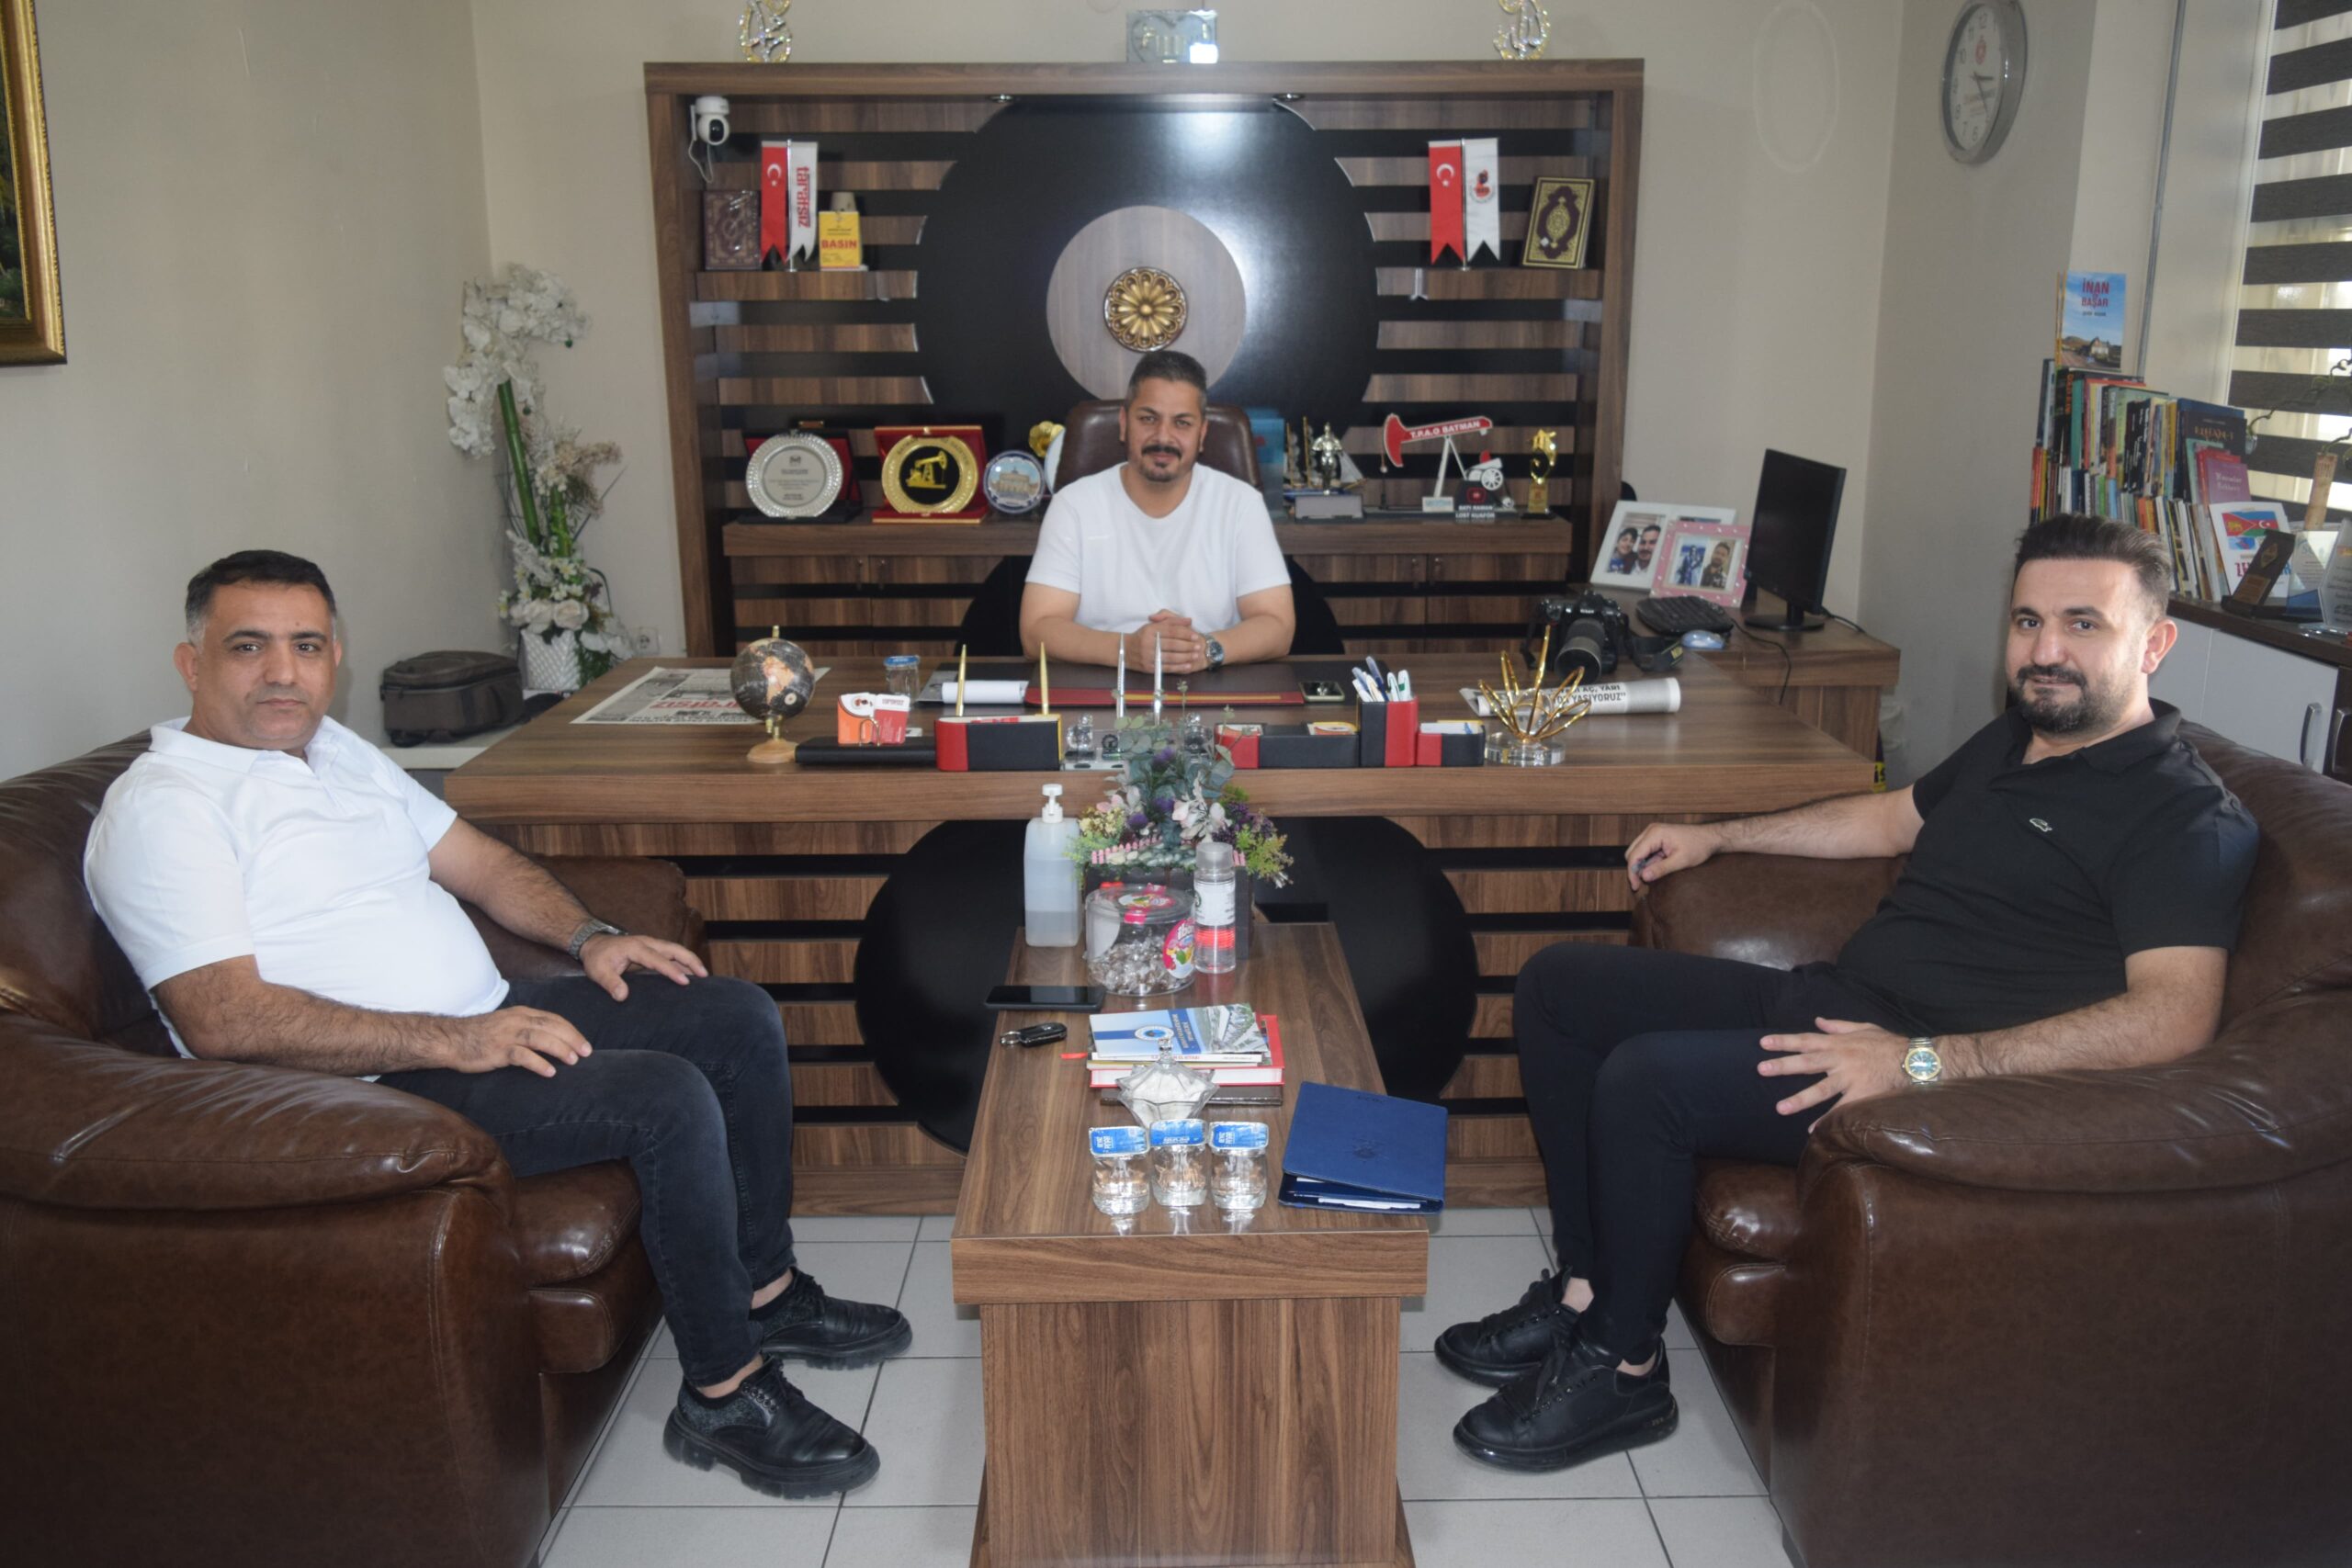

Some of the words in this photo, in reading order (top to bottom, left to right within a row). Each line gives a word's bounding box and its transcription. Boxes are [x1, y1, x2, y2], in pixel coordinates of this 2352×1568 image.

[820, 239, 857, 249] BASIN
[2082, 277, 2109, 294] İNAN
[1442, 422, 1480, 433] BATMAN
